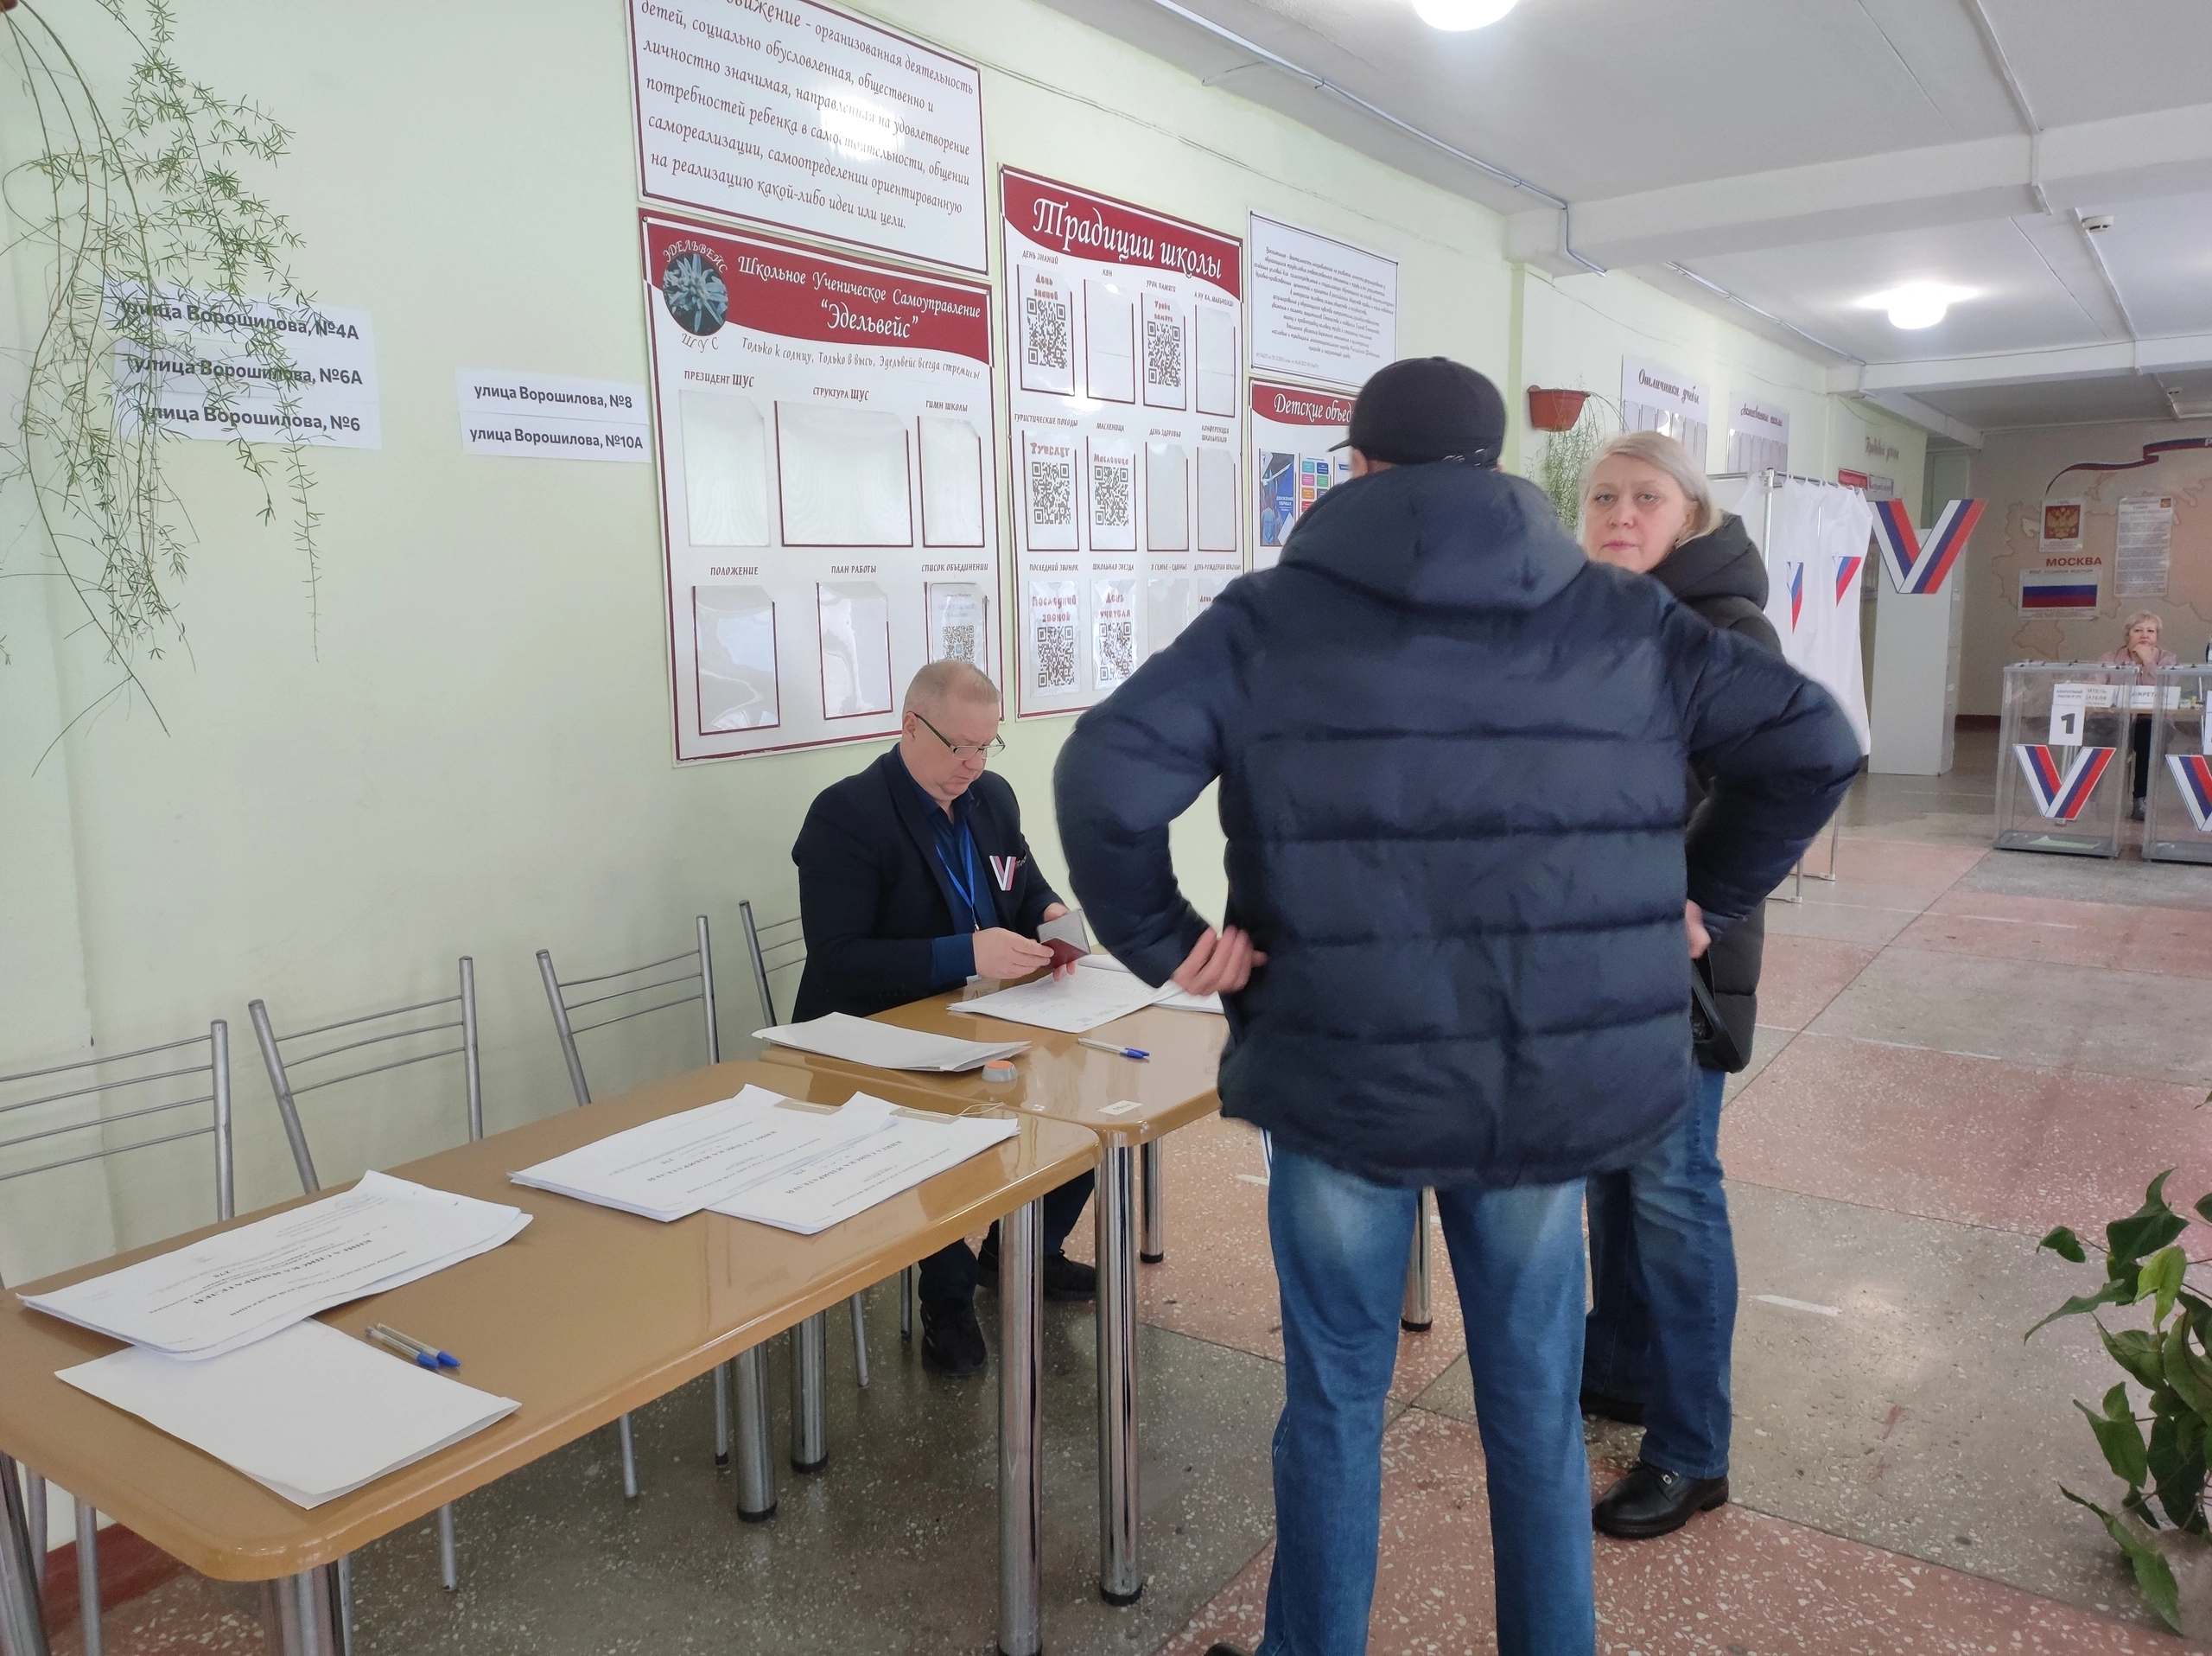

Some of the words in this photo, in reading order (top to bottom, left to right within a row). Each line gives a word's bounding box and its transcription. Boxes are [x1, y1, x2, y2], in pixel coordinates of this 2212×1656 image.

[641, 1, 687, 29] детей,
[692, 19, 761, 50] социально
[766, 40, 854, 86] обусловленная,
[858, 73, 925, 109] общественно
[927, 101, 934, 112] и
[727, 0, 800, 27] вижение
[815, 24, 902, 67] организованная
[905, 54, 973, 94] деятельность
[643, 40, 721, 73] личностно
[724, 65, 791, 99] значимая,
[879, 115, 890, 129] на
[893, 117, 969, 156] удовлетворение
[646, 77, 746, 117] потребностей
[749, 106, 798, 136] ребенка
[801, 124, 808, 135] в
[929, 161, 969, 186] общении
[648, 116, 763, 160] самореализации,
[768, 149, 868, 185] самоопределении
[871, 178, 963, 215] ориентированную
[651, 153, 668, 168] на
[671, 158, 753, 189] реализацию
[757, 181, 826, 207] какой-либо
[829, 194, 854, 213] идеи
[857, 207, 877, 220] или
[880, 212, 906, 228] цели.
[1033, 197, 1154, 262] Традиции
[1160, 242, 1222, 279] школы
[663, 239, 728, 274] ЭДЕЛЬВЕЙС
[1021, 249, 1036, 260] ДЕНЬ
[1037, 253, 1058, 264] ЗНАНИЙ
[1102, 269, 1113, 277] КВН
[738, 256, 806, 283] Школьное
[812, 271, 886, 303] Ученическое
[893, 289, 981, 318] Самоуправление
[1146, 280, 1158, 289] УРОК
[742, 337, 772, 355] Только
[775, 344, 779, 357] к
[783, 350, 814, 366] солнцу,
[818, 351, 845, 365] Только
[848, 352, 853, 365] в
[855, 353, 875, 367] высь,
[879, 355, 916, 371] Эдельвейс
[918, 358, 940, 373] всегда
[200, 360, 315, 385] Ворошилова,
[320, 367, 363, 385] №6А
[684, 371, 730, 385] ПРЕЗИДЕНТ
[733, 373, 754, 388] ШУС
[474, 385, 517, 400] улица
[519, 386, 607, 409] Ворошилова,
[609, 394, 632, 409] №8
[812, 386, 849, 399] СТРУКТУРА
[850, 388, 869, 401] ШУС
[925, 400, 944, 411] ГИМН
[945, 402, 968, 412] ШКОЛЫ
[1274, 393, 1324, 423] Детские
[1325, 399, 1354, 423] объед
[204, 406, 327, 431] Ворошилова,
[330, 415, 360, 431] №6
[1014, 413, 1056, 425] ТУРИСТИЧЕСКИЕ
[1058, 418, 1078, 428] ПОХОДЫ
[1096, 422, 1125, 432] МАСЛЕНИЦА
[469, 429, 512, 443] улица
[514, 429, 603, 449] Ворошилова,
[605, 435, 644, 449] №10А
[710, 566, 759, 576] ПОЛОЖЕНИЕ
[831, 565, 850, 574] ПЛАН
[851, 565, 877, 574] РАБОТЫ
[922, 564, 945, 572] СПИСОК
[1029, 563, 1058, 571] ПОСЛЕДНИЙ
[1058, 563, 1079, 571] ЗВОНОК
[2046, 557, 2102, 567] МОСКВА
[2061, 713, 2075, 734] 1
